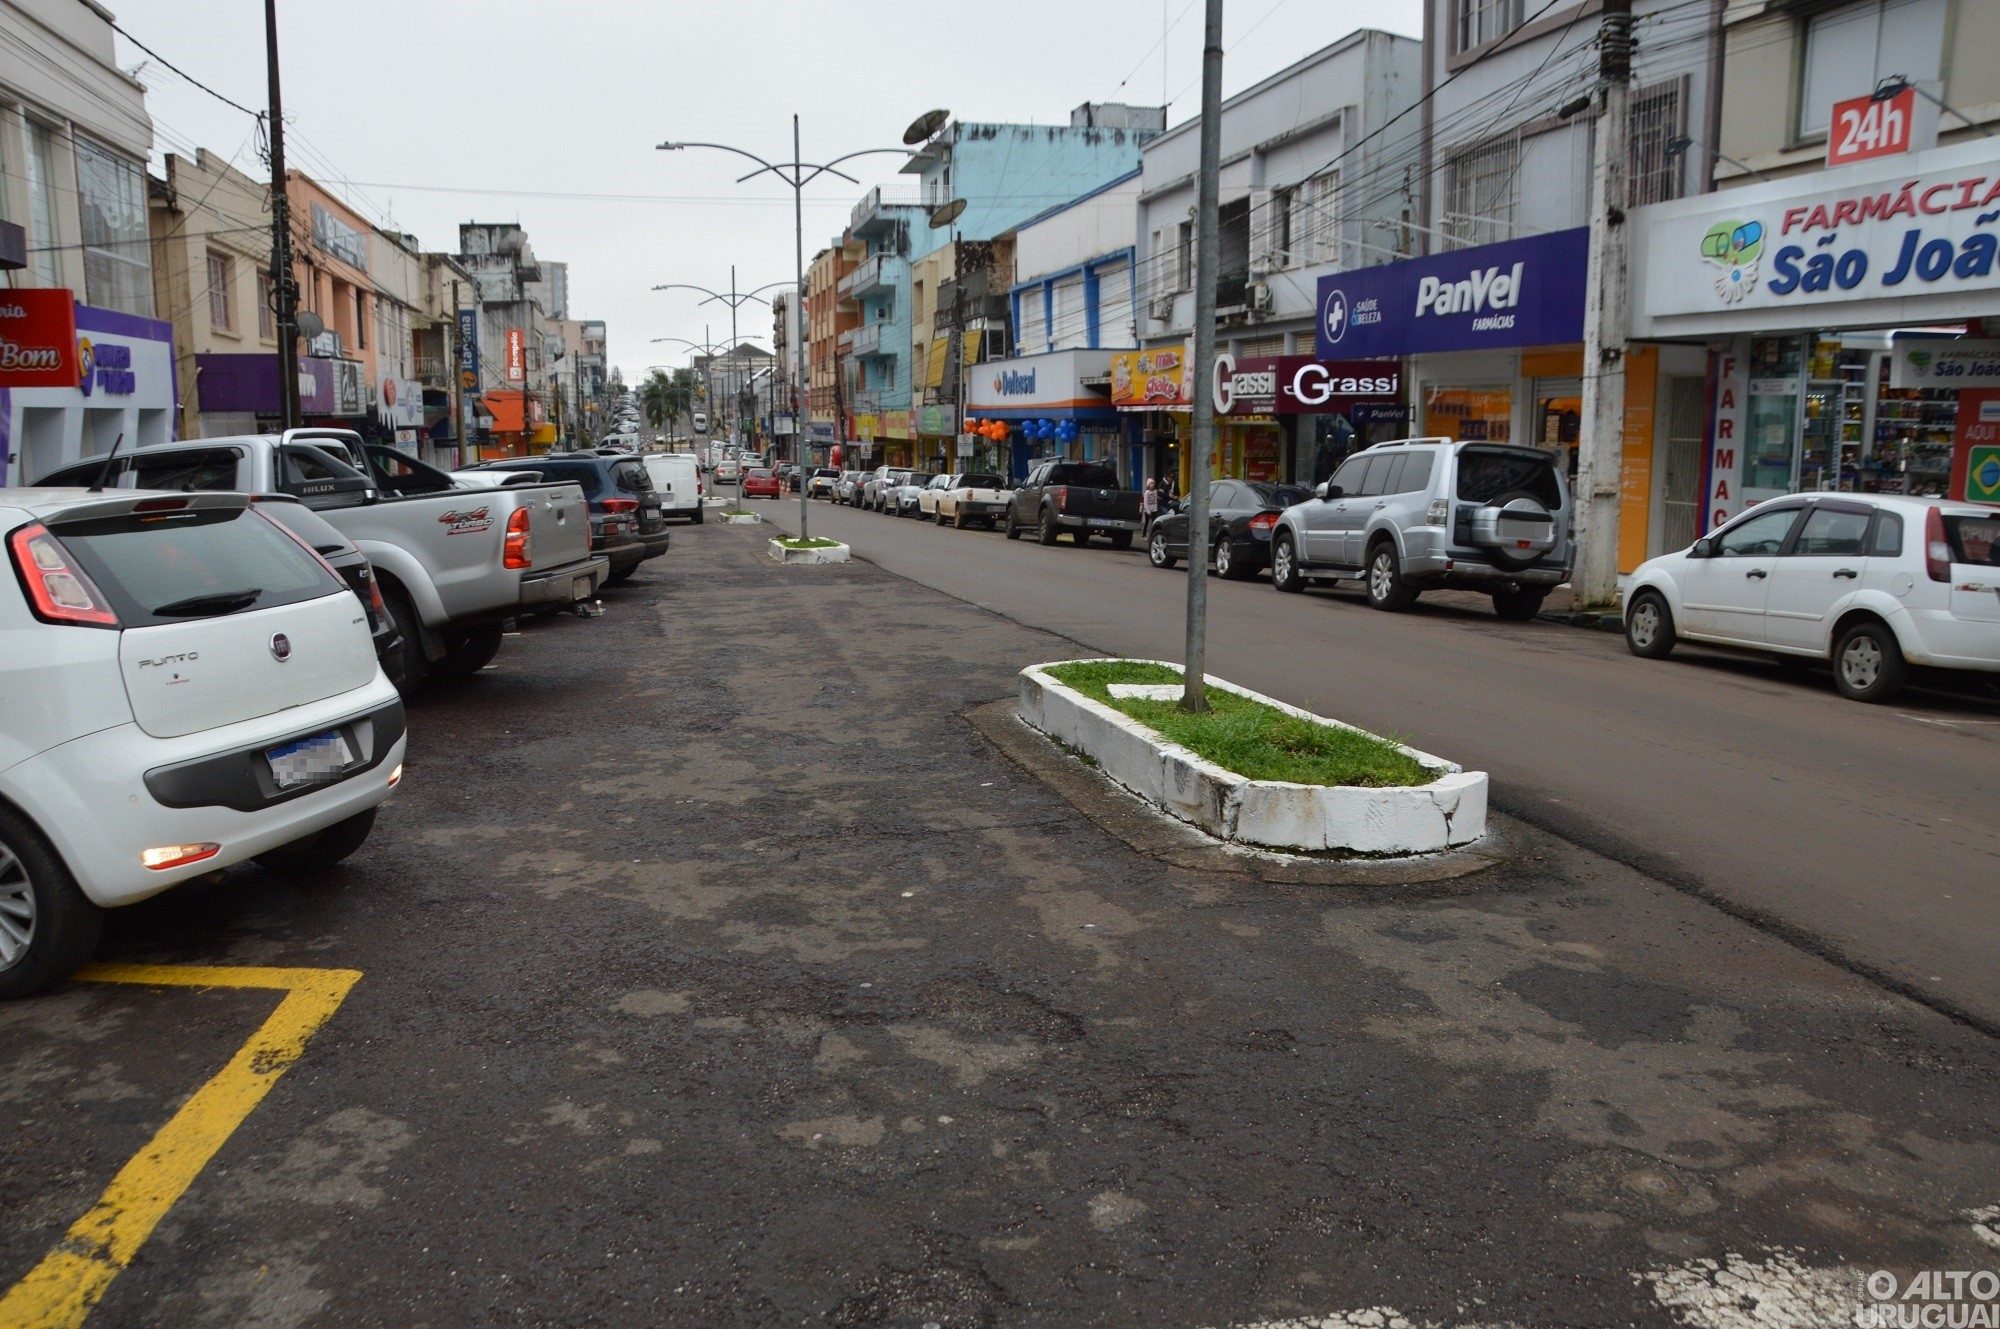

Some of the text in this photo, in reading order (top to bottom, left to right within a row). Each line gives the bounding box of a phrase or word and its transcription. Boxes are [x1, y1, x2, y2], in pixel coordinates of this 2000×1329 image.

[1837, 99, 1904, 157] 24h
[1768, 210, 2000, 296] São Joã
[1356, 298, 1378, 312] SAÚDE
[1415, 262, 1524, 318] PanVel
[1359, 311, 1382, 325] BELEZA
[1472, 314, 1515, 332] FARMÁCIAS
[1213, 353, 1276, 414] Grassi
[1291, 363, 1398, 405] Grassi
[302, 484, 335, 494] HILUX
[138, 651, 199, 669] PUNTO
